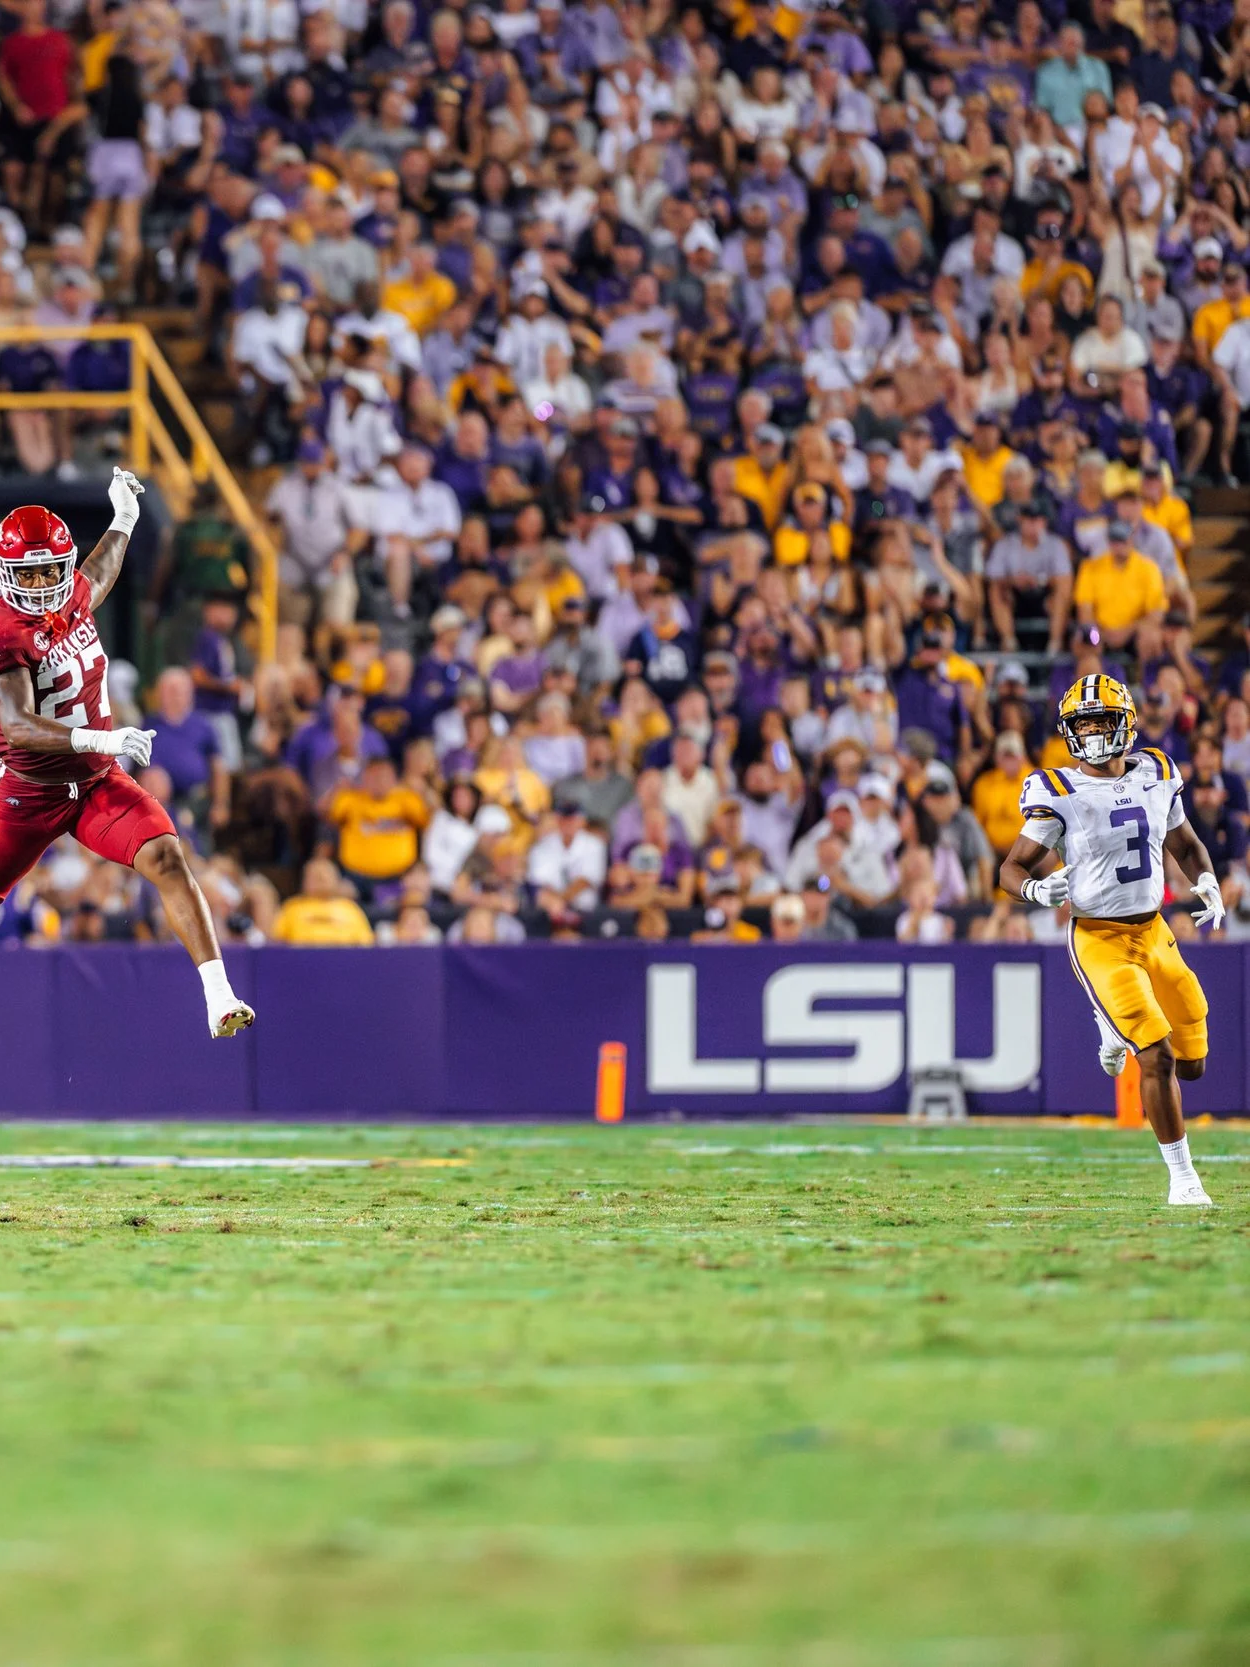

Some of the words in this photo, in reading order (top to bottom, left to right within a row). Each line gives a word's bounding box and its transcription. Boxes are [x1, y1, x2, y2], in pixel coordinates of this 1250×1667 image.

[36, 638, 112, 729] 27
[1083, 700, 1098, 708] LSU
[1115, 797, 1133, 806] LSU
[1109, 806, 1152, 884] 3
[647, 963, 1042, 1093] LSU
